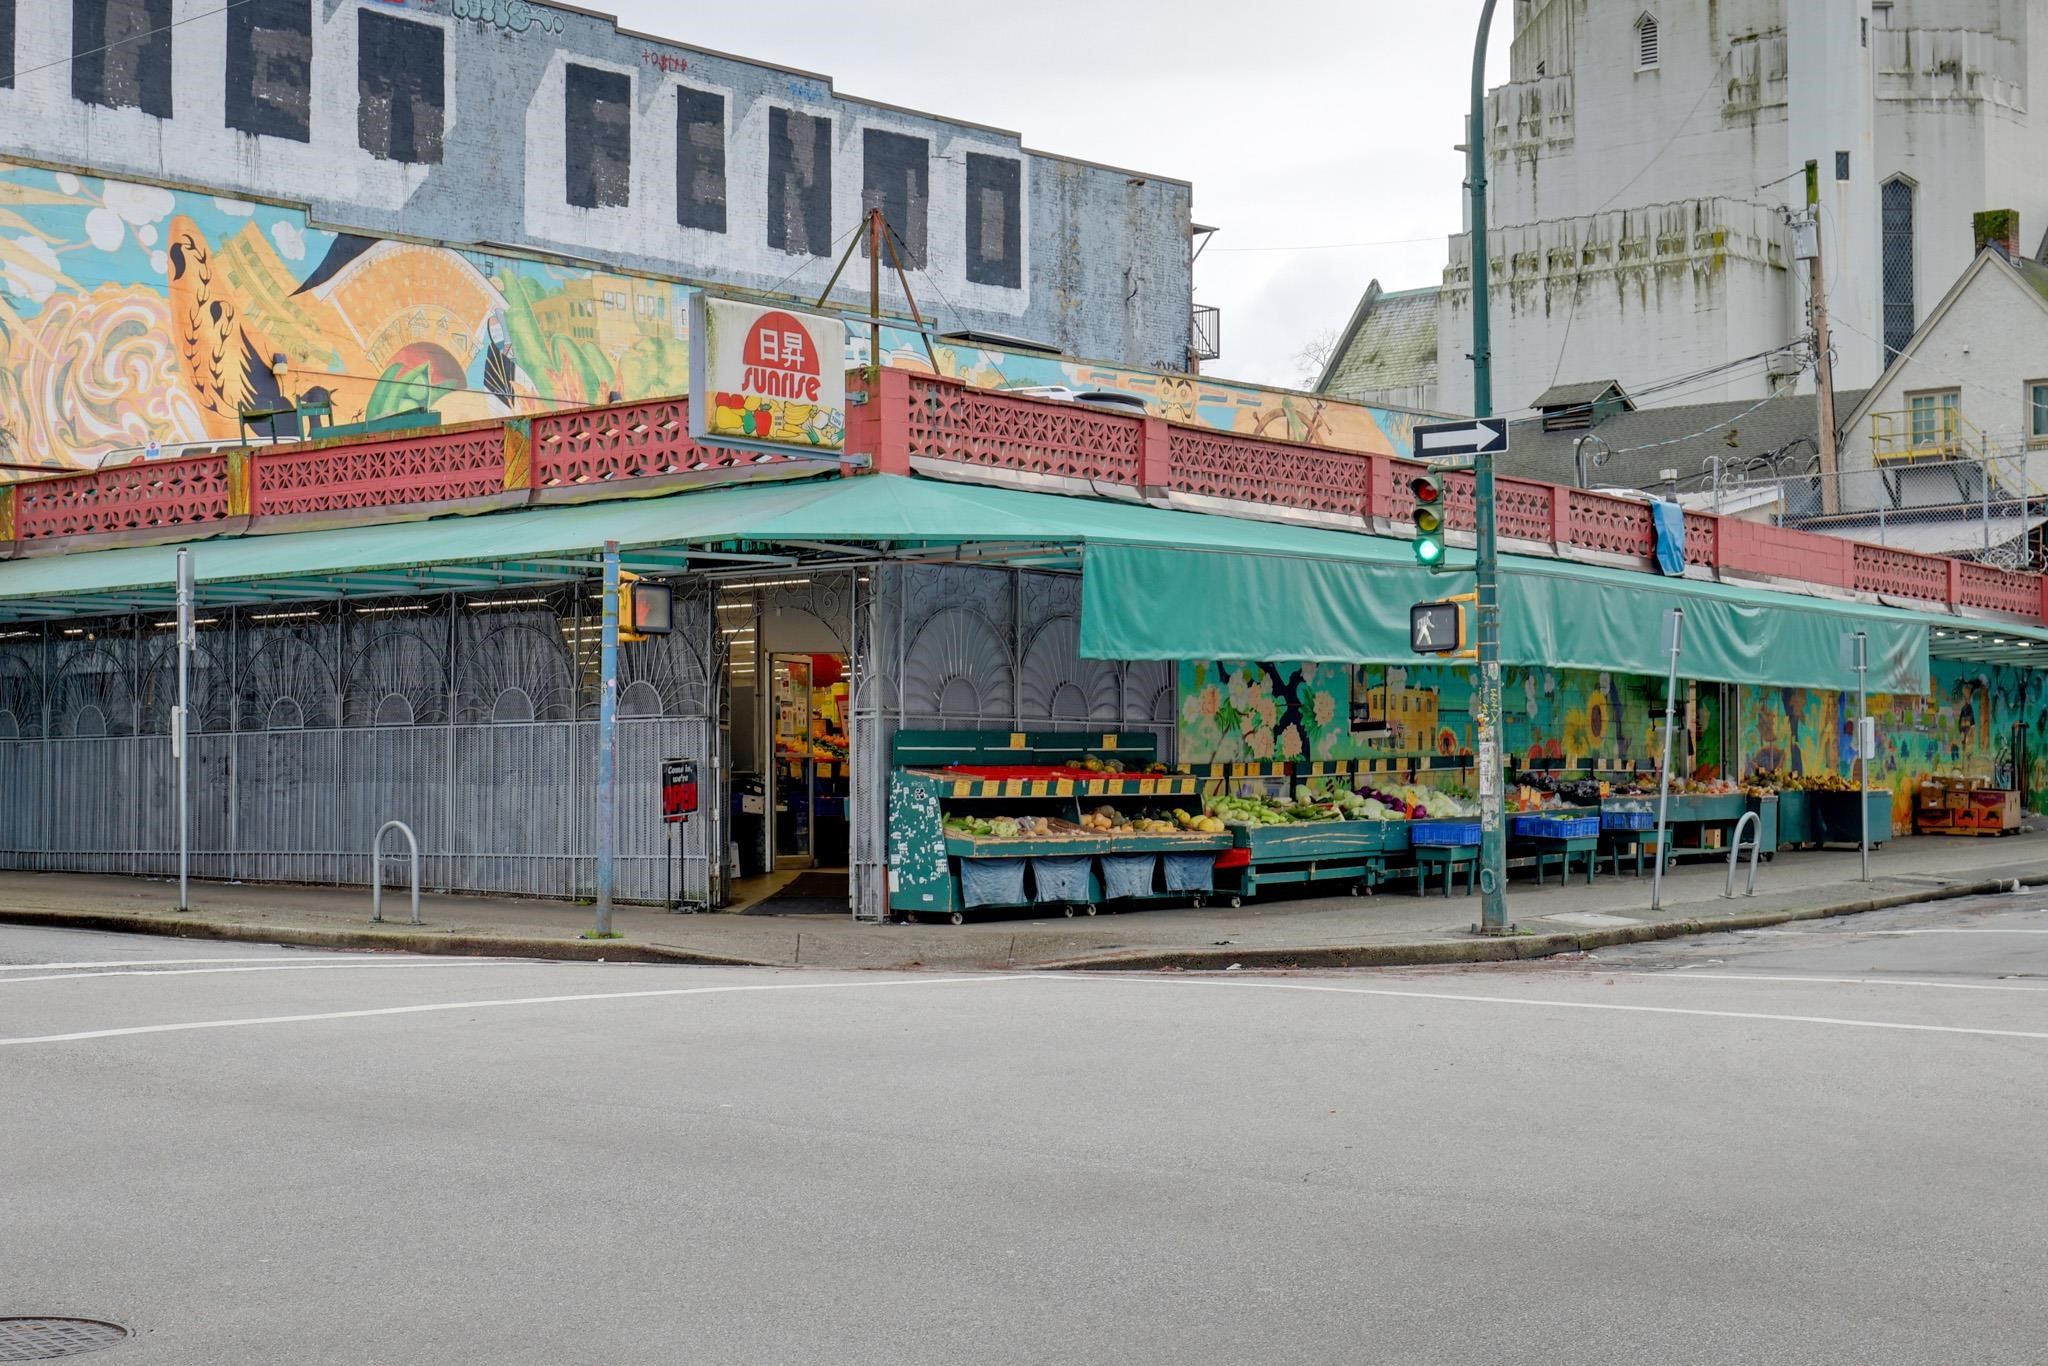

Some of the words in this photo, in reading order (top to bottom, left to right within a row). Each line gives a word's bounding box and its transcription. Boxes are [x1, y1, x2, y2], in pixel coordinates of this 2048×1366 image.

[759, 328, 805, 370] 日昇
[667, 766, 684, 775] Come
[664, 784, 696, 813] OPEN
